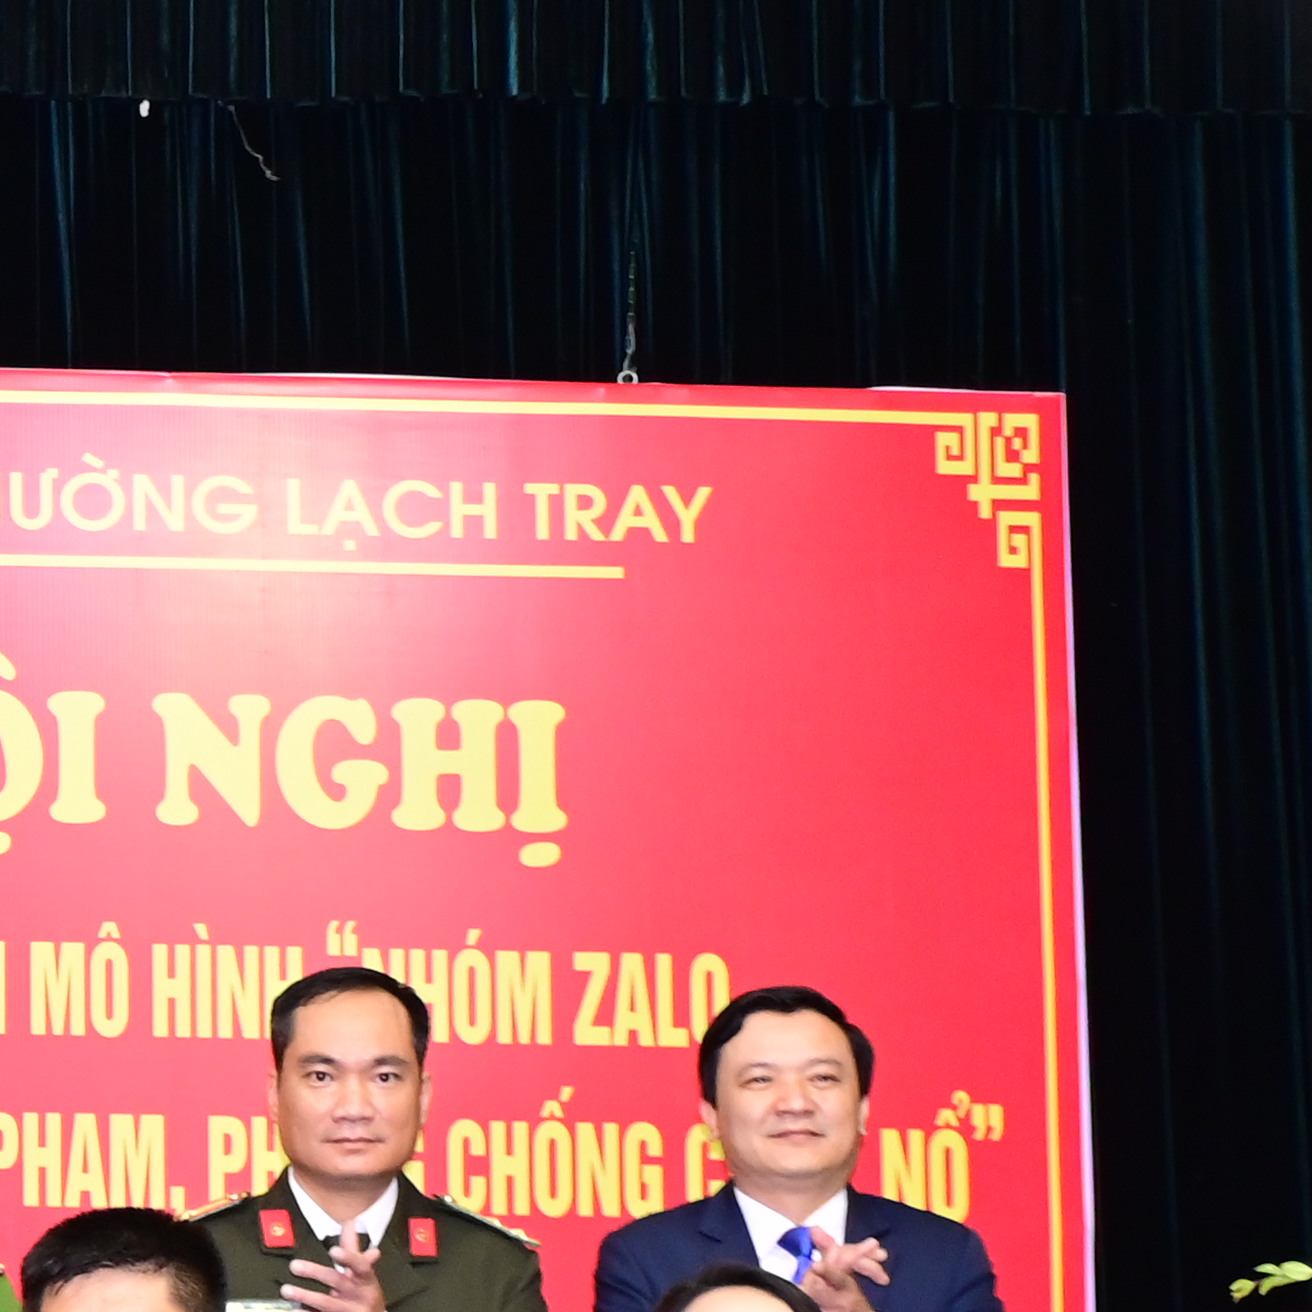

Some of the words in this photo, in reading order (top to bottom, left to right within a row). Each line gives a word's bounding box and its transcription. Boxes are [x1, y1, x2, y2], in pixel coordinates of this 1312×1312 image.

[286, 479, 498, 551] LẠCH
[523, 481, 713, 544] TRAY
[151, 691, 568, 868] NGHỊ
[29, 920, 130, 1039] MÔ
[151, 922, 304, 1040] HÌNH
[572, 951, 732, 1048] ZALO
[445, 1085, 665, 1219] CHỐNG
